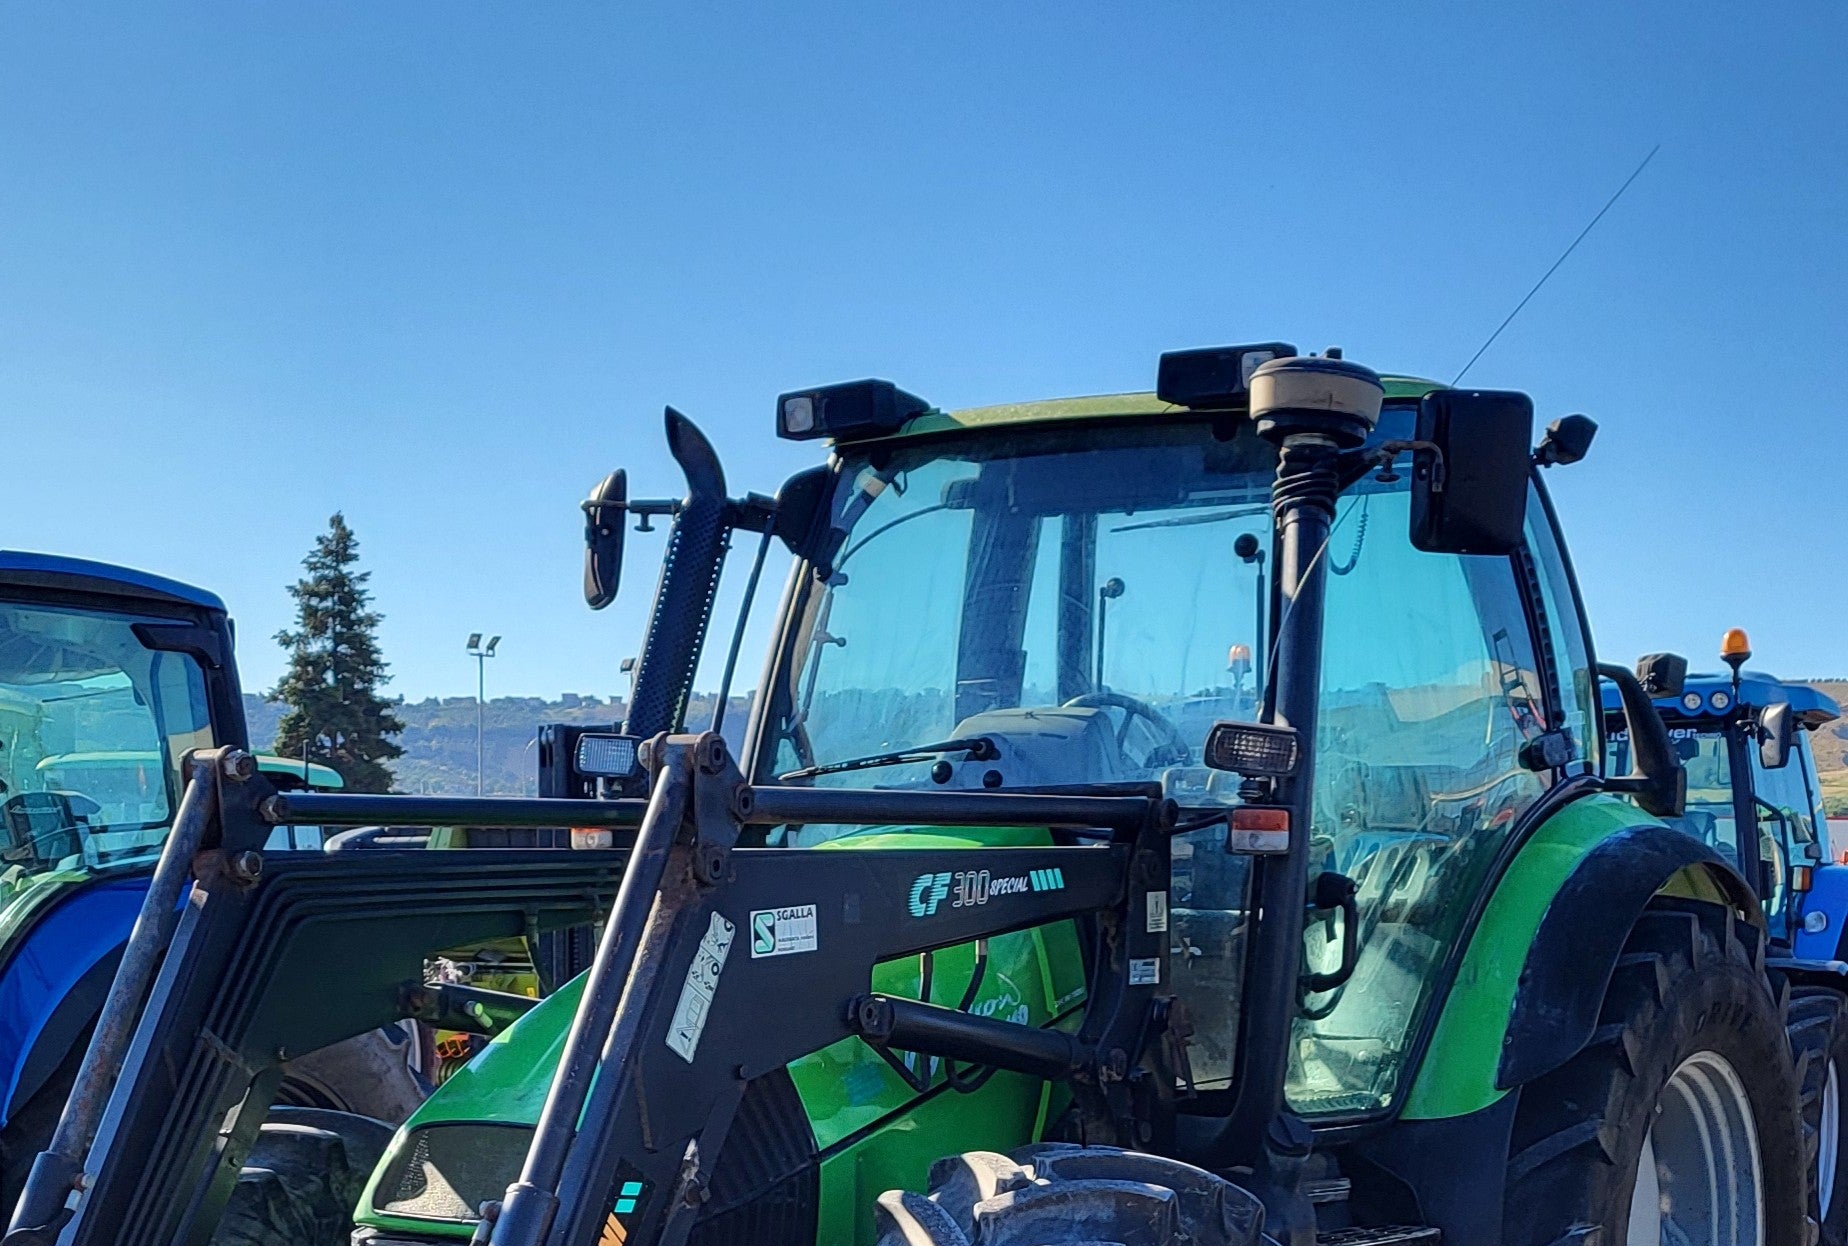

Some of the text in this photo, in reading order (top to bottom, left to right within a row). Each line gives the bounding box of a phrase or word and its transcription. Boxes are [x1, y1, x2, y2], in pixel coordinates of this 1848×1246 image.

[952, 869, 990, 908] 300
[989, 876, 1029, 896] SPECIAL
[776, 906, 814, 921] SGALLA
